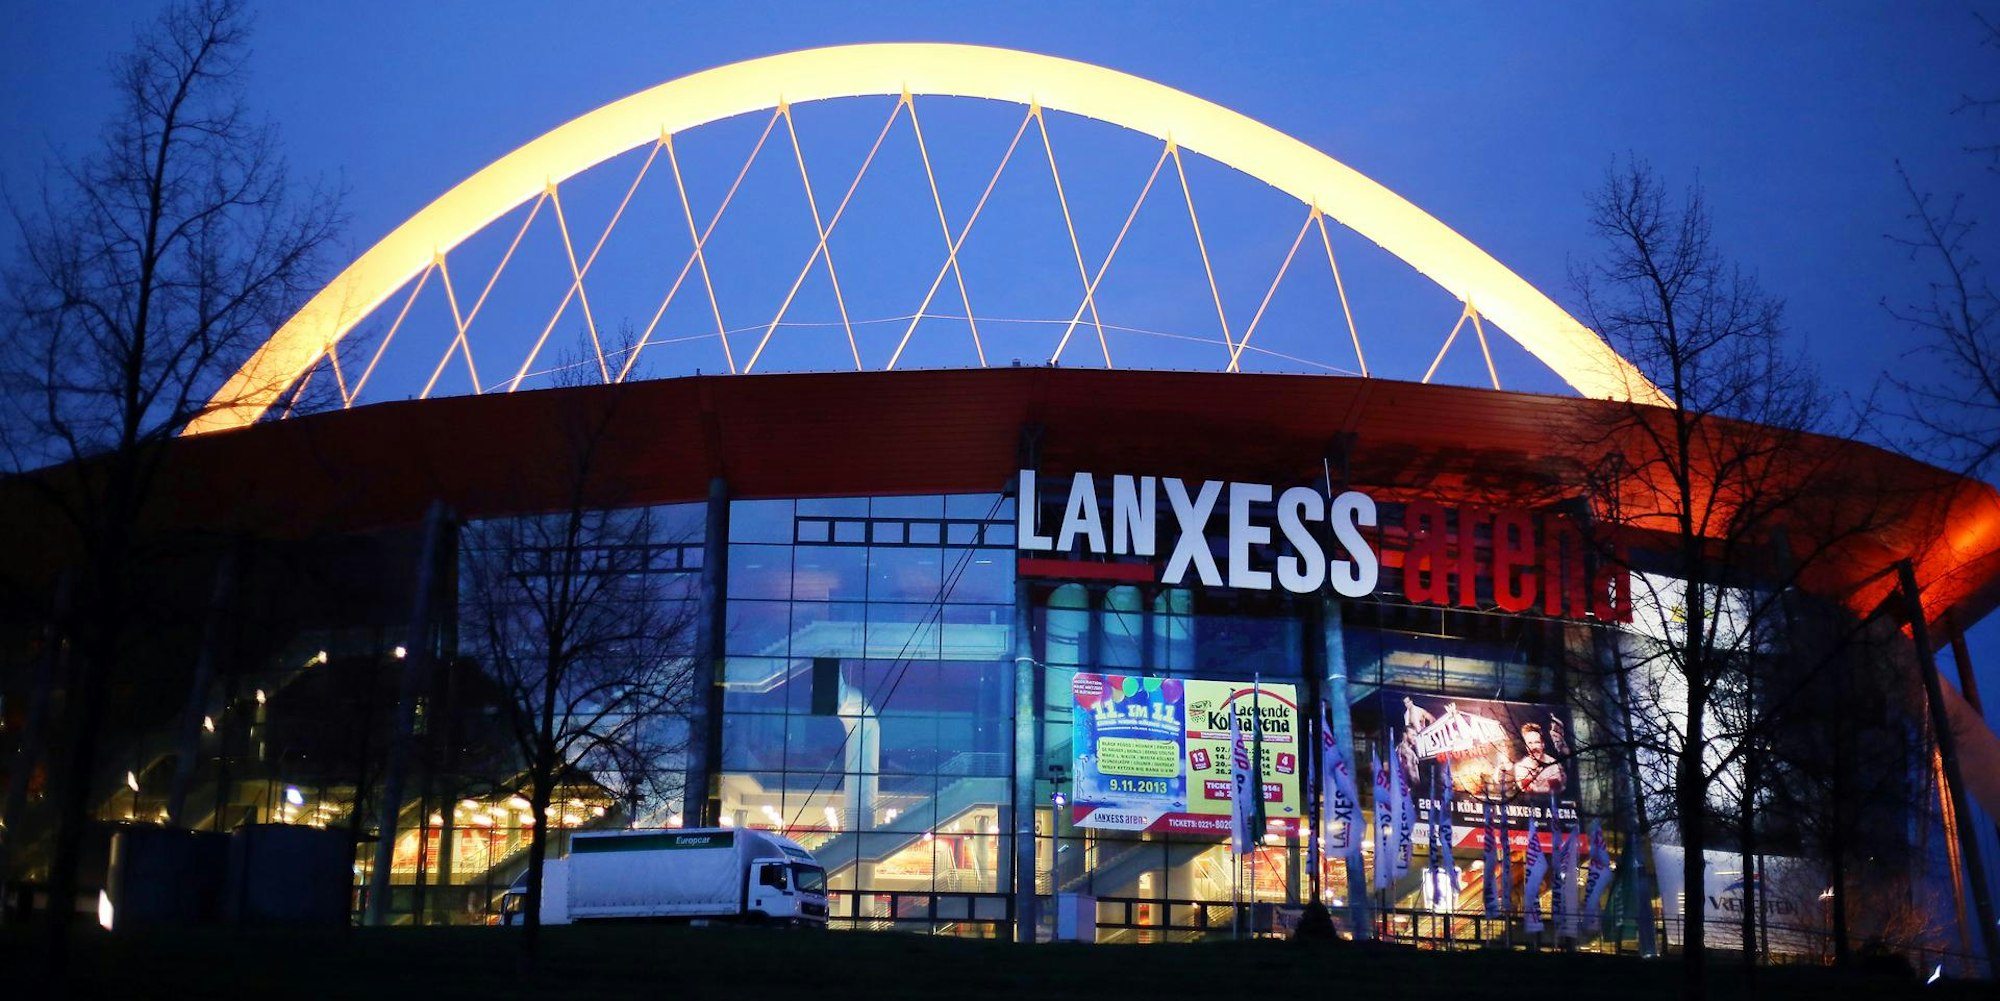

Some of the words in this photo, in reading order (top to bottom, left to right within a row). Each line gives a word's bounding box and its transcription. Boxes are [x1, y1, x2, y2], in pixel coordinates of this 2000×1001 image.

[1019, 469, 1379, 598] LANXESS
[1404, 499, 1634, 623] arena
[1128, 704, 1149, 718] IM
[1234, 703, 1290, 718] Lacende
[1193, 752, 1205, 763] 13
[1281, 756, 1289, 766] 4
[1110, 779, 1167, 793] 9.11.2013
[1456, 799, 1484, 815] KÖLN
[1496, 804, 1541, 818] LNXES
[1545, 808, 1578, 820] AENA
[1094, 813, 1124, 825] LANXESS
[676, 836, 711, 846] Europcar
